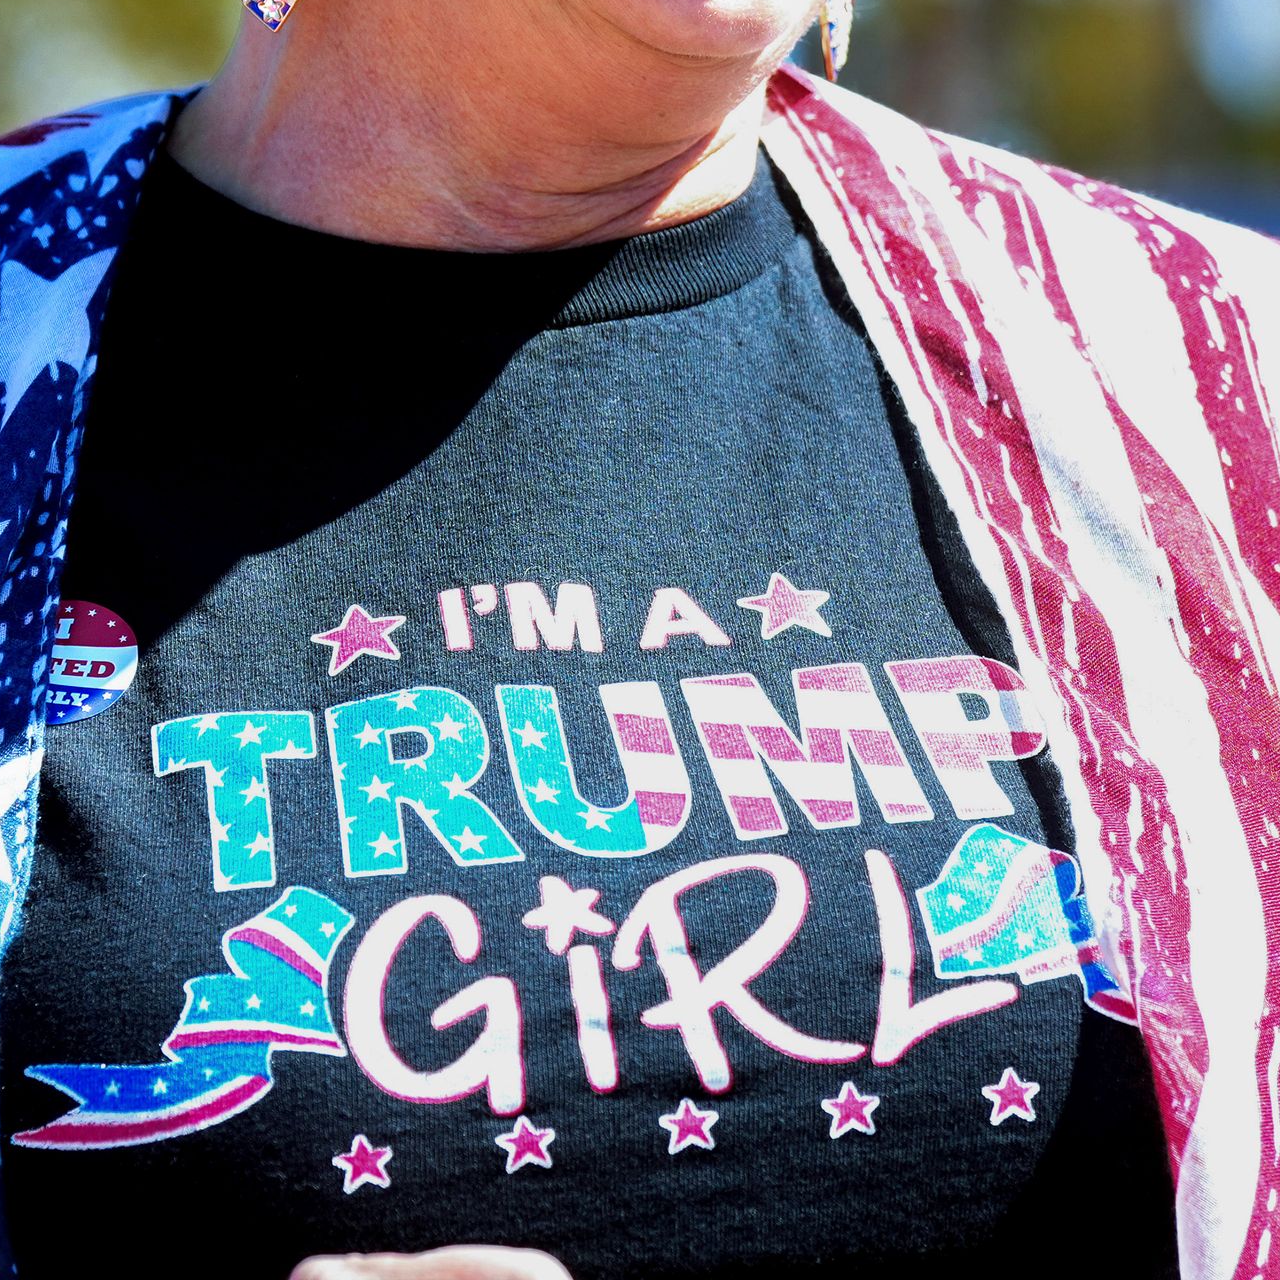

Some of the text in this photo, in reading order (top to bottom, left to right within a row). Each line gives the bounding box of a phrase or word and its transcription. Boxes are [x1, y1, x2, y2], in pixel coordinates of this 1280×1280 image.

[438, 581, 731, 653] I'M A
[55, 618, 74, 639] I
[50, 658, 115, 678] TED
[46, 690, 89, 707] RLY
[151, 655, 1048, 892] TRUMP
